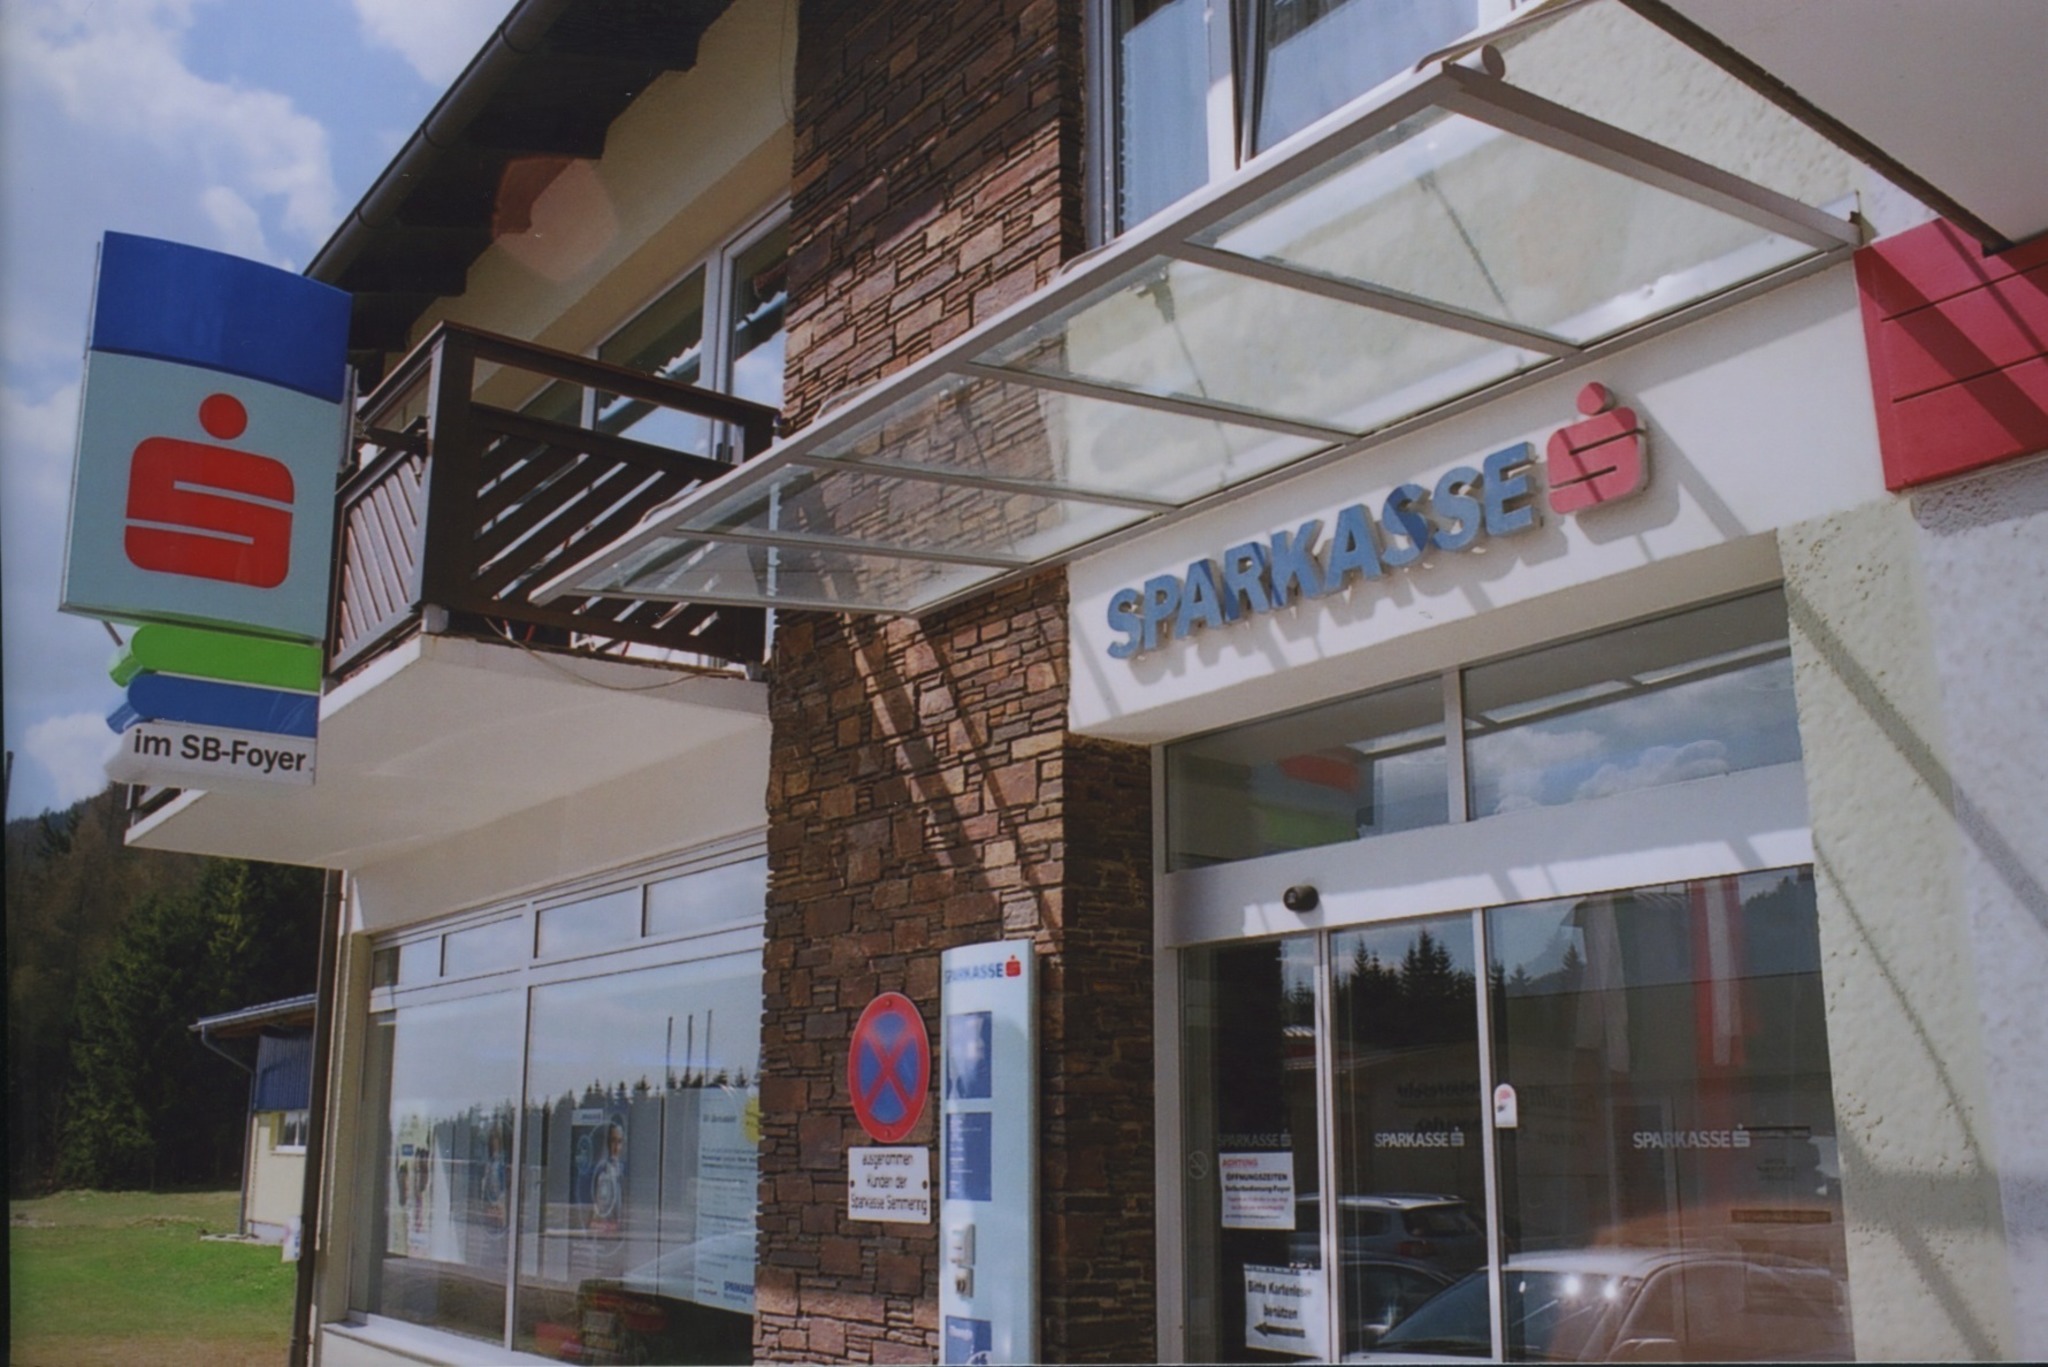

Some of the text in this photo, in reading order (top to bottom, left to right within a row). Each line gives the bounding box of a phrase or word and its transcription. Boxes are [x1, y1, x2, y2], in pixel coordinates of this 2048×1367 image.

[1106, 441, 1535, 659] SPARKASSE
[133, 729, 306, 774] im SB-Foyer
[1374, 1132, 1449, 1148] SPARKASSE
[1633, 1130, 1731, 1149] SPARKASSE
